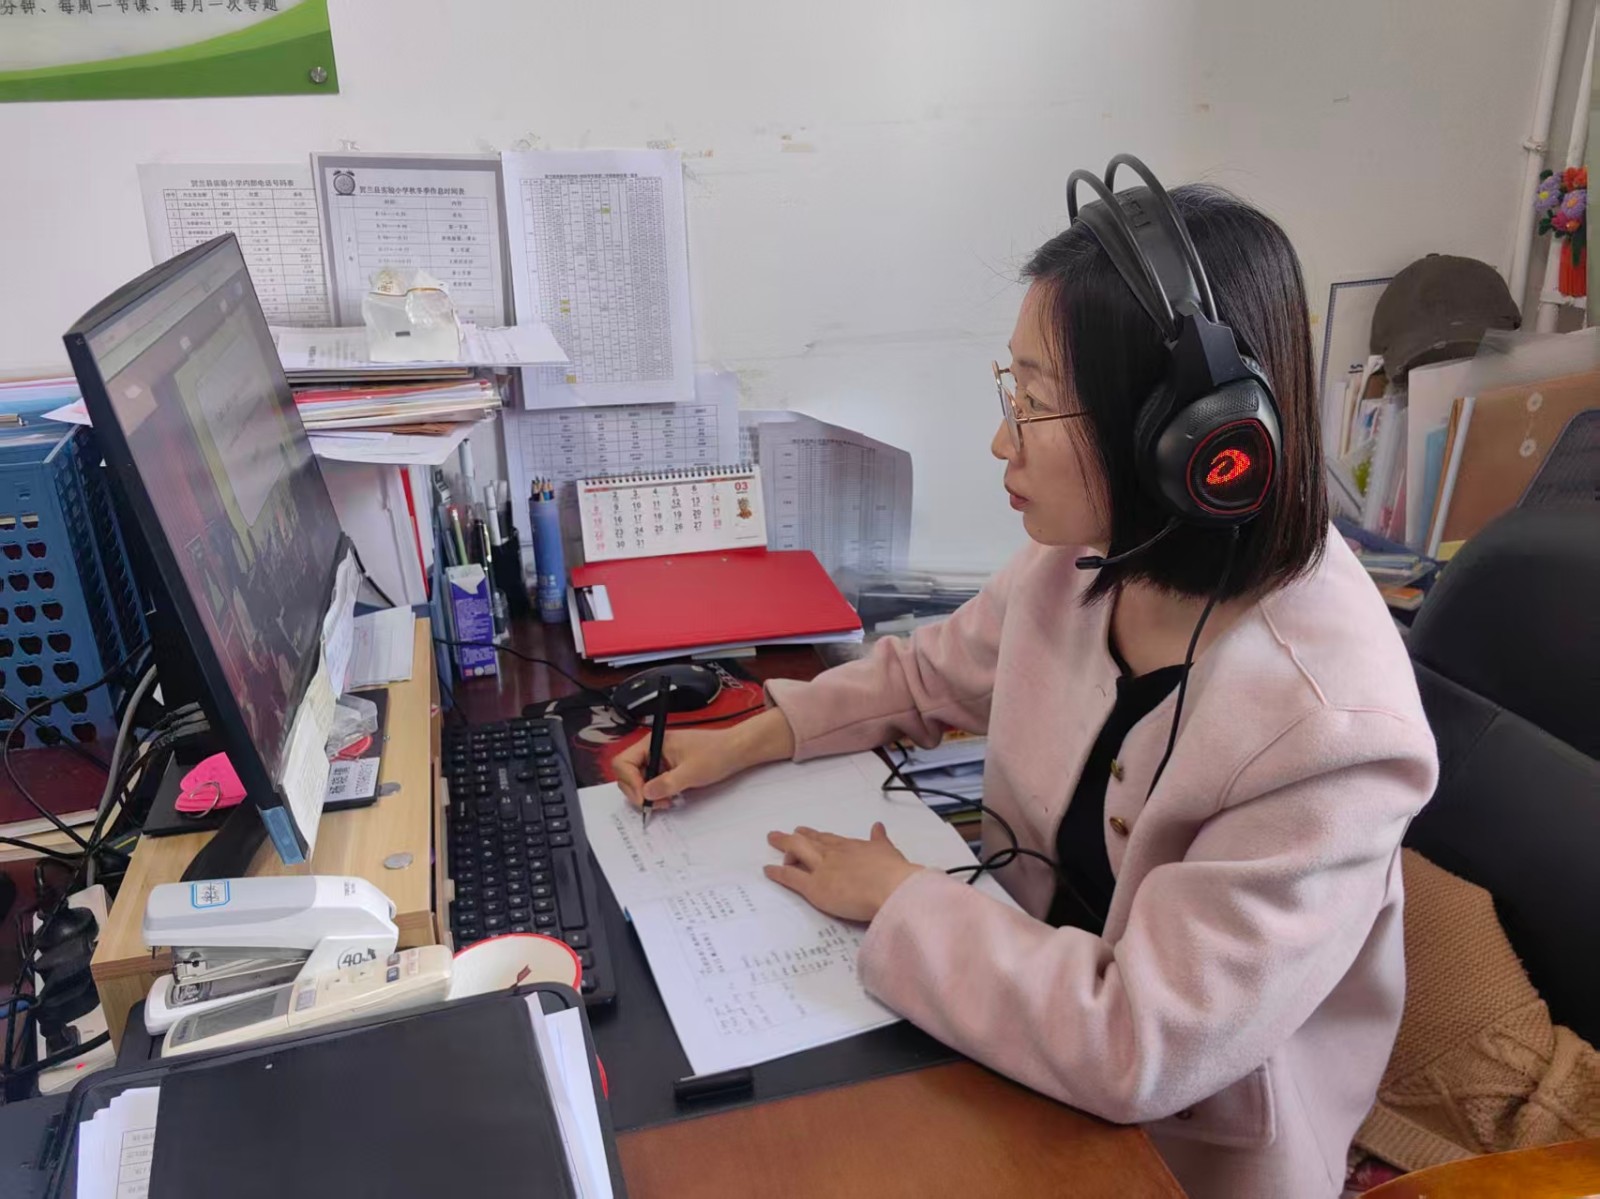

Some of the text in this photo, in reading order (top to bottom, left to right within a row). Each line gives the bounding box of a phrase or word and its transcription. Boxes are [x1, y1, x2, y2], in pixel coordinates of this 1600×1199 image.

[734, 482, 748, 490] 03
[636, 539, 645, 547] 31
[342, 952, 362, 967] 40
